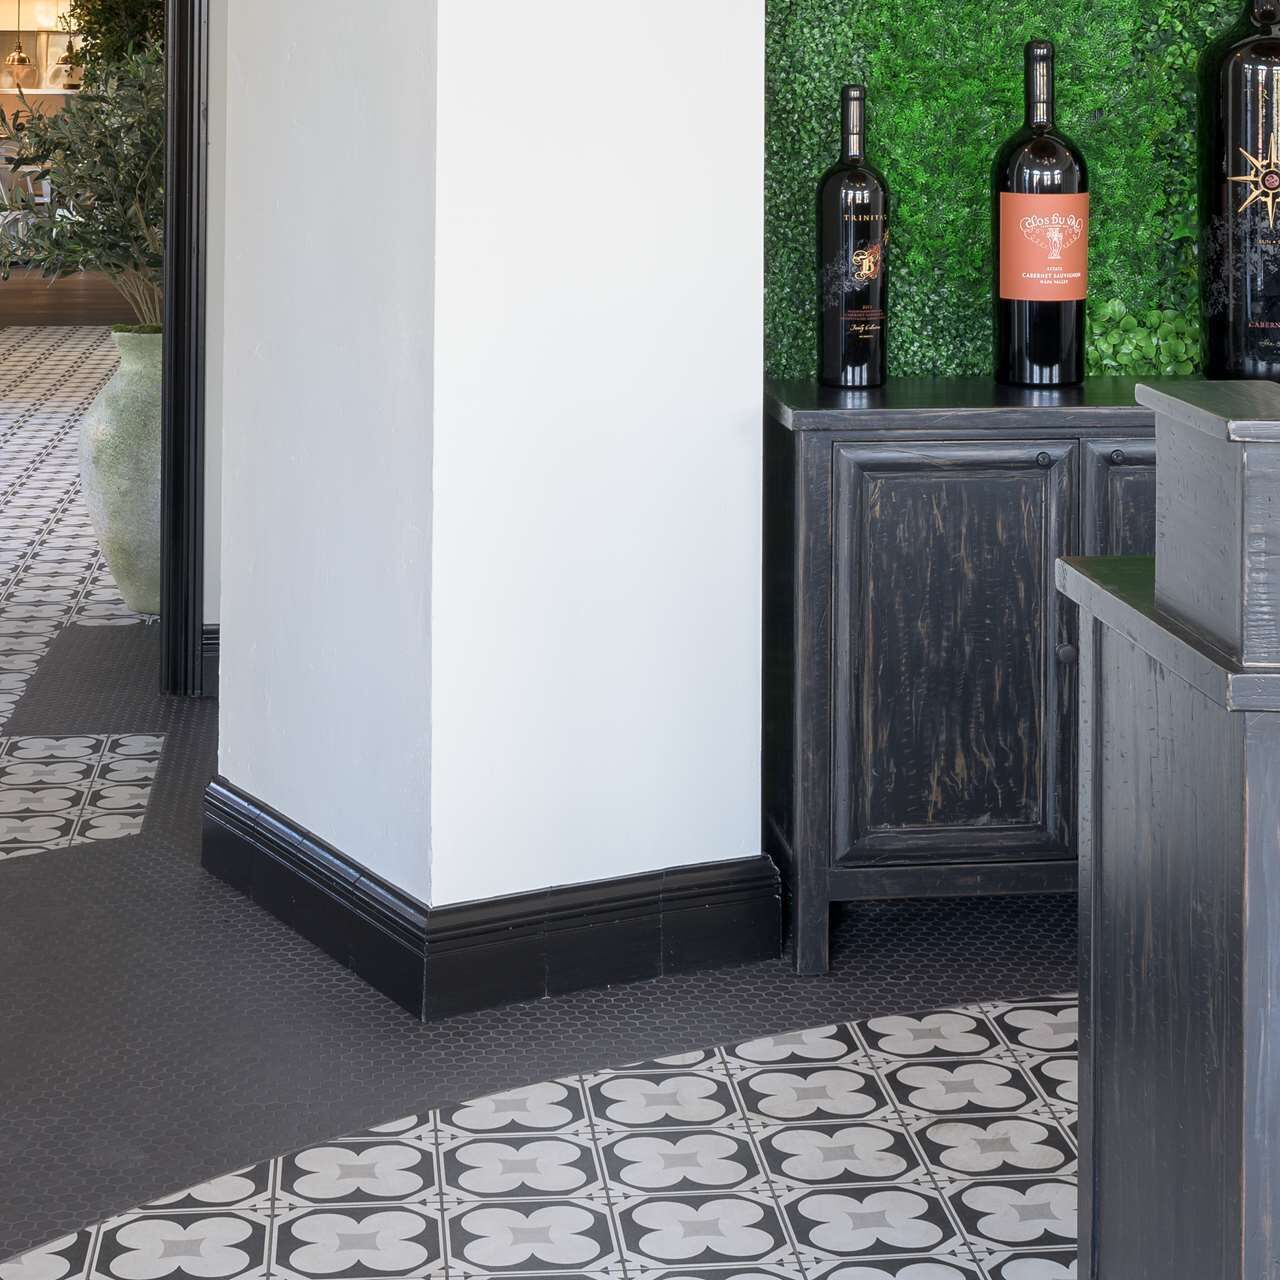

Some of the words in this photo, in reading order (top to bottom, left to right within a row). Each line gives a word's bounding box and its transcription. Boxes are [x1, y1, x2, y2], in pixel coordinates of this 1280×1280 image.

[1025, 215, 1050, 228] CLOS
[1051, 213, 1065, 225] DU
[1066, 214, 1081, 229] VAL
